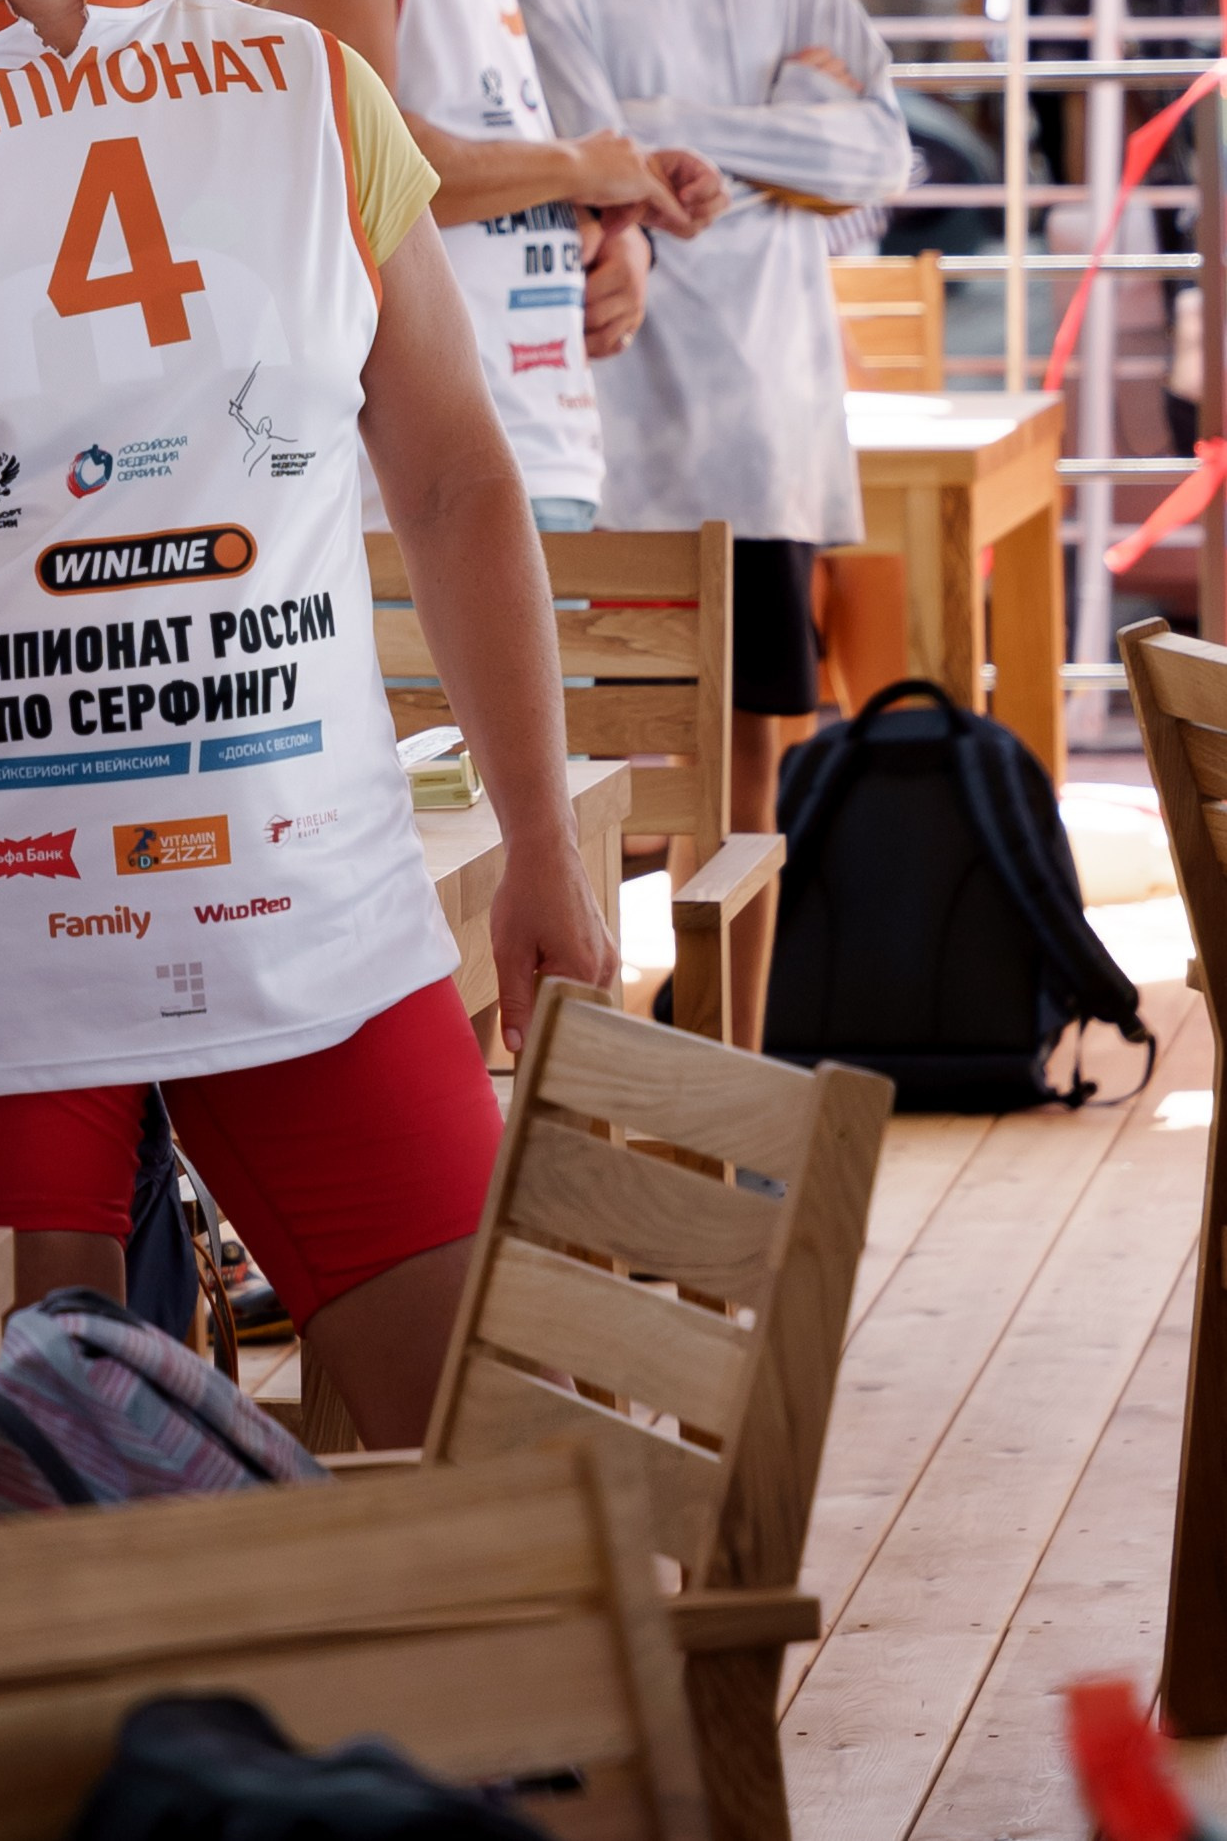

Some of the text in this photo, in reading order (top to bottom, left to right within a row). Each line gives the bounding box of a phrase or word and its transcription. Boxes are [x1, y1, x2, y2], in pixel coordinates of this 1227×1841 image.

[47, 137, 206, 348] 4
[55, 538, 208, 584] WINLINE
[209, 591, 336, 658] РОССИИ
[68, 662, 299, 736] СЕРФИНГУ
[82, 763, 92, 775] И
[95, 754, 170, 774] ВЕЙКСКИМ
[218, 741, 266, 762] «ДОСКА
[266, 739, 273, 753] С
[296, 808, 339, 829] FIRELINE
[159, 831, 216, 848] VITAMIN
[26, 847, 64, 862] Банк
[48, 905, 151, 939] Family
